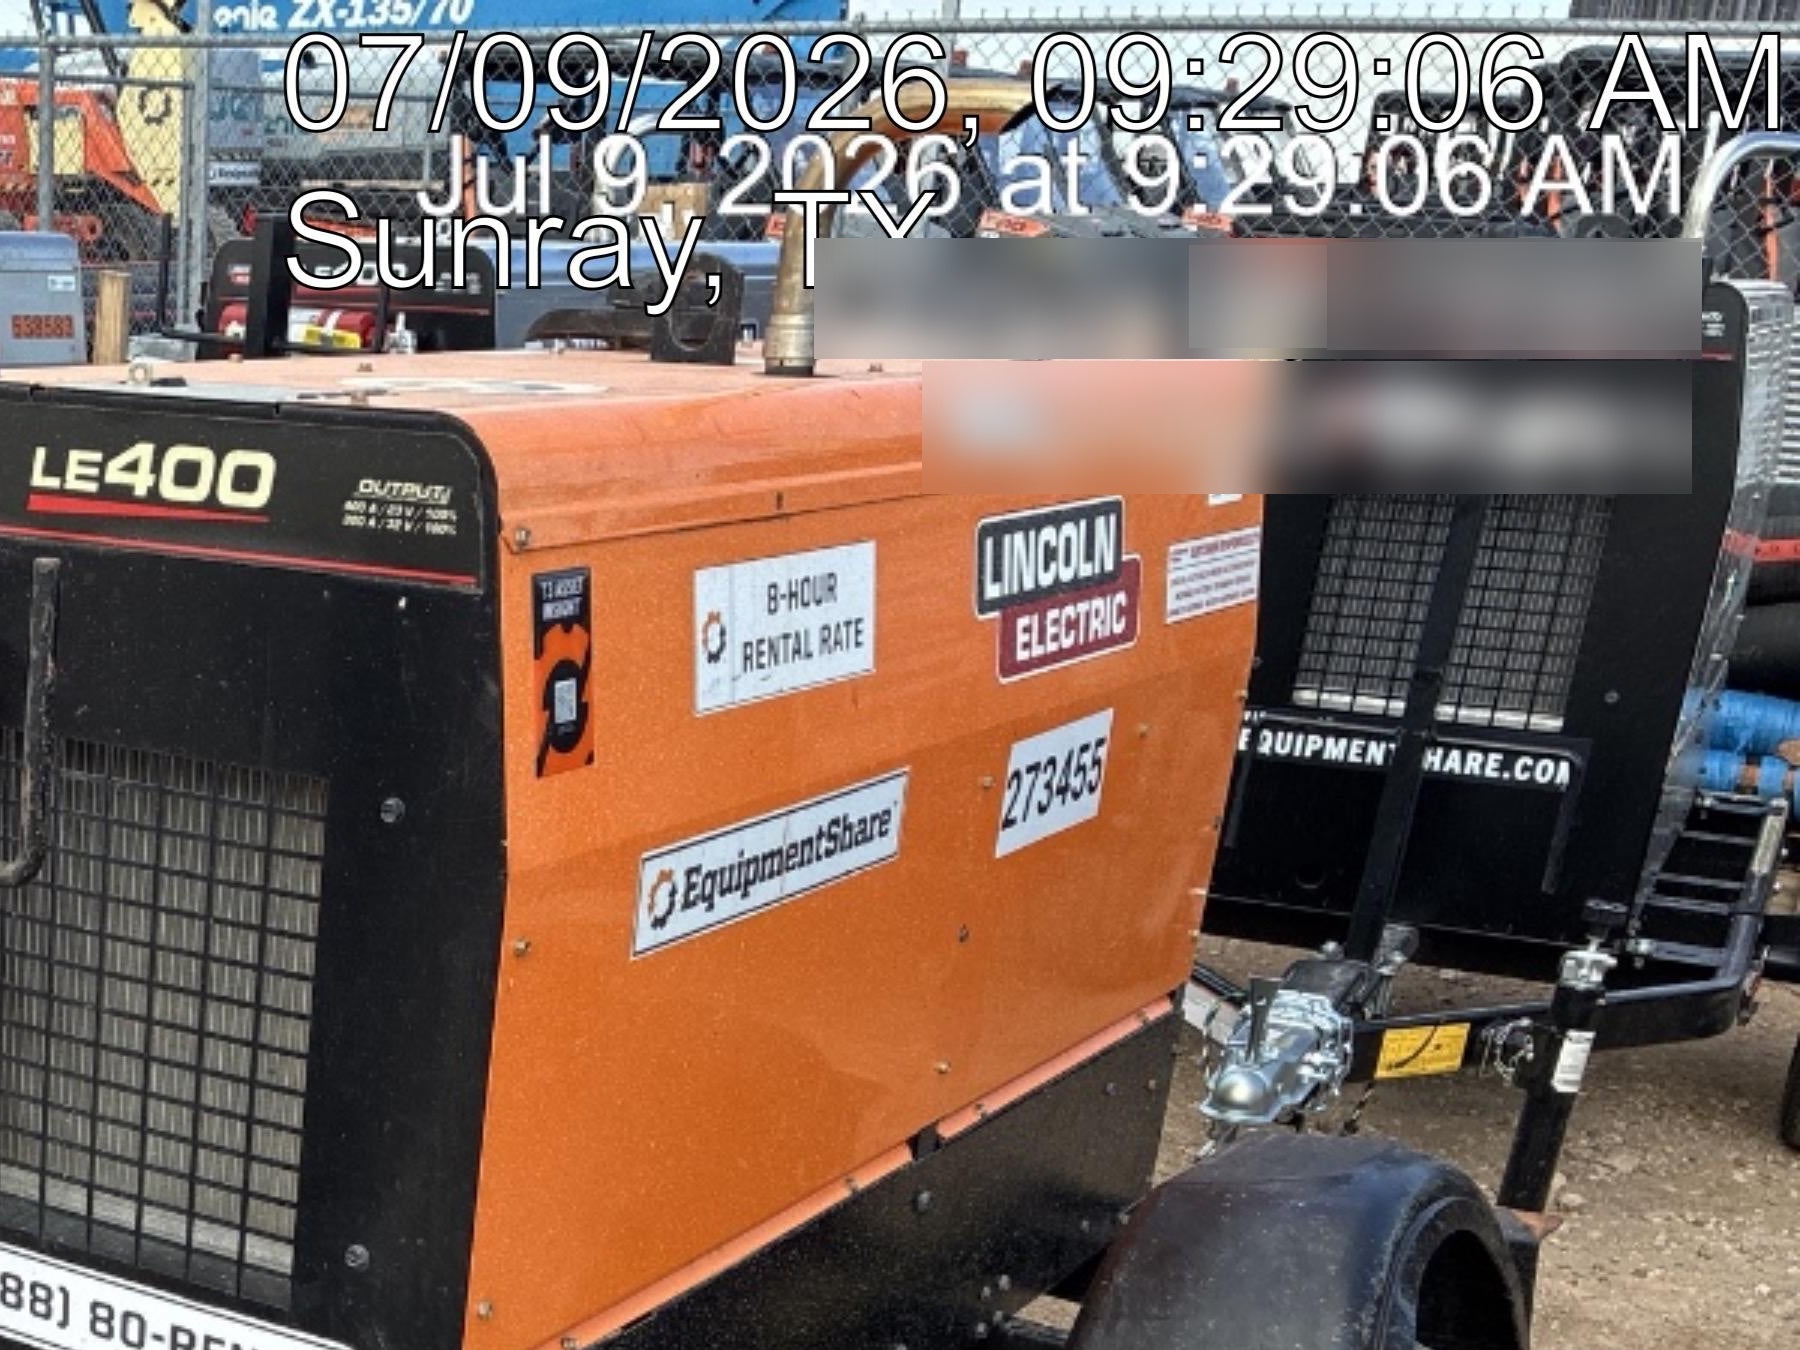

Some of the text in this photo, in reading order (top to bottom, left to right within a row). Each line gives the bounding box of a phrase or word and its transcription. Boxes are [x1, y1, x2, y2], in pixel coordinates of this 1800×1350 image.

[213, 3, 280, 29] enie
[29, 442, 277, 508] LE400
[984, 513, 1117, 600] LINCOLN
[767, 572, 837, 615] 8-HOUR
[1016, 590, 1127, 662] ELECTRIC
[743, 617, 864, 673] RENTAL RATE
[1001, 737, 1107, 830] 273455
[680, 807, 892, 913] EquipmentShare
